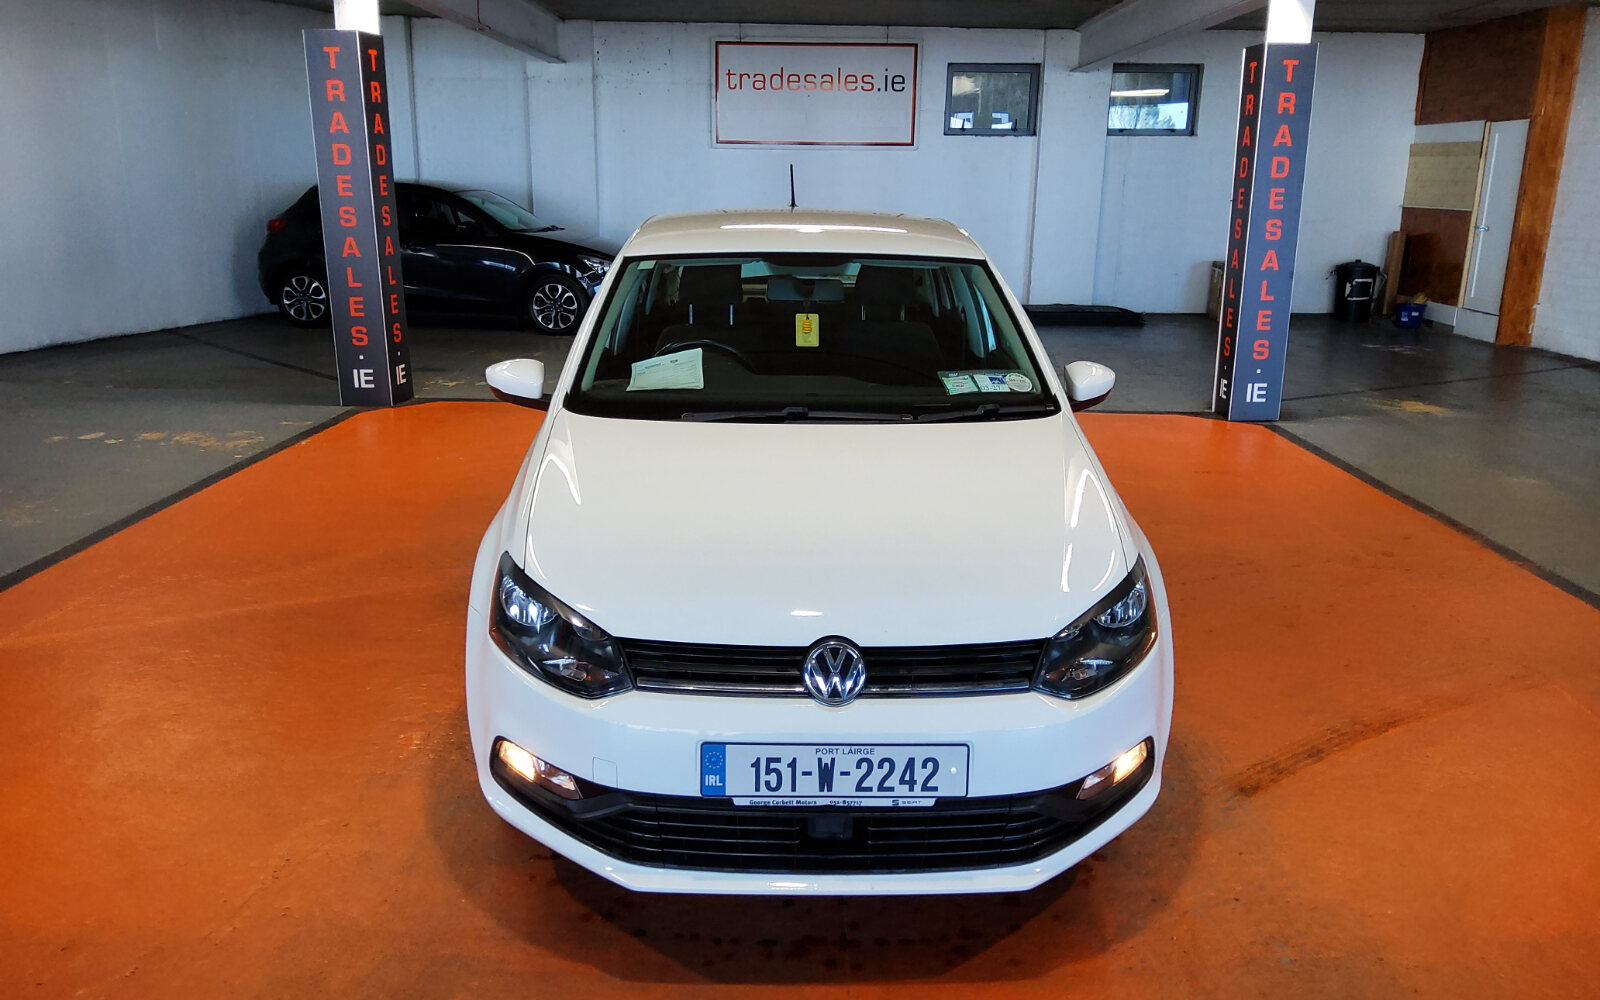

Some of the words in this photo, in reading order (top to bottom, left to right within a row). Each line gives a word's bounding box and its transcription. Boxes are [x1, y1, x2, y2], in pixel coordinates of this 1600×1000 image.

[725, 67, 906, 93] tradesales.ie
[815, 747, 840, 755] PORT
[842, 745, 876, 755] LÁIRGE
[705, 774, 723, 786] IRL
[750, 756, 940, 793] 151-W-2242
